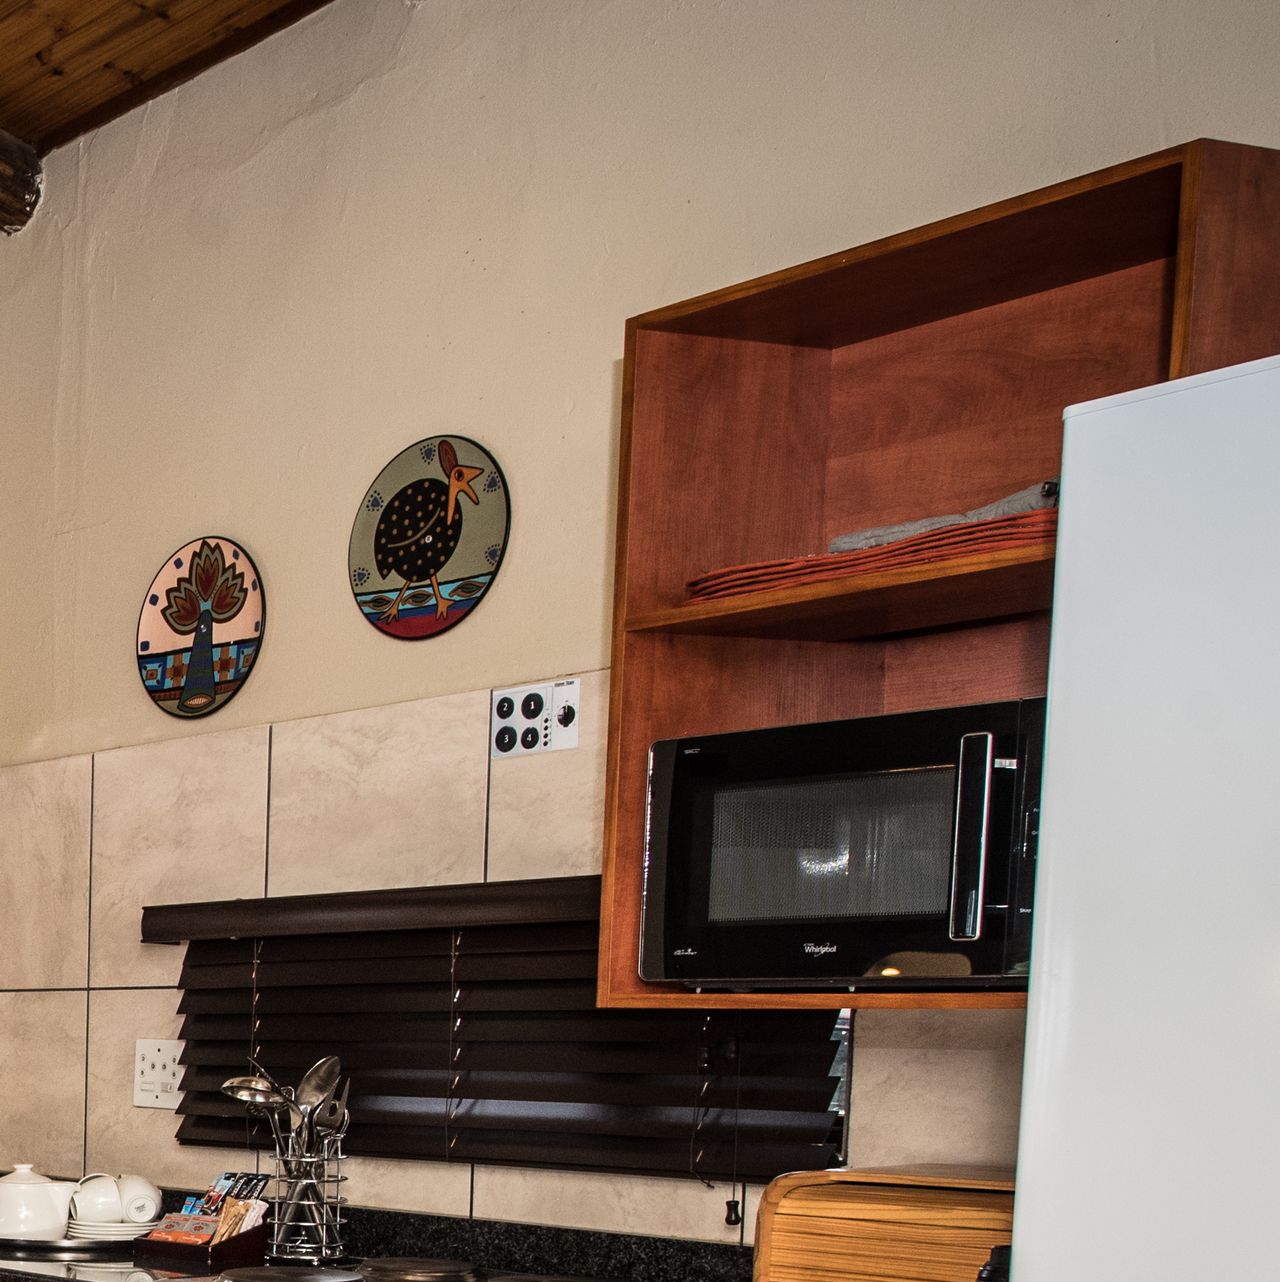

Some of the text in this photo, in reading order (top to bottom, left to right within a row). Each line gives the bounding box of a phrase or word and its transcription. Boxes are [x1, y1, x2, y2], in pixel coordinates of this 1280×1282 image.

[503, 703, 508, 711] 2
[530, 701, 535, 709] 1
[504, 734, 509, 743] 3
[804, 943, 837, 954] Whirlpool
